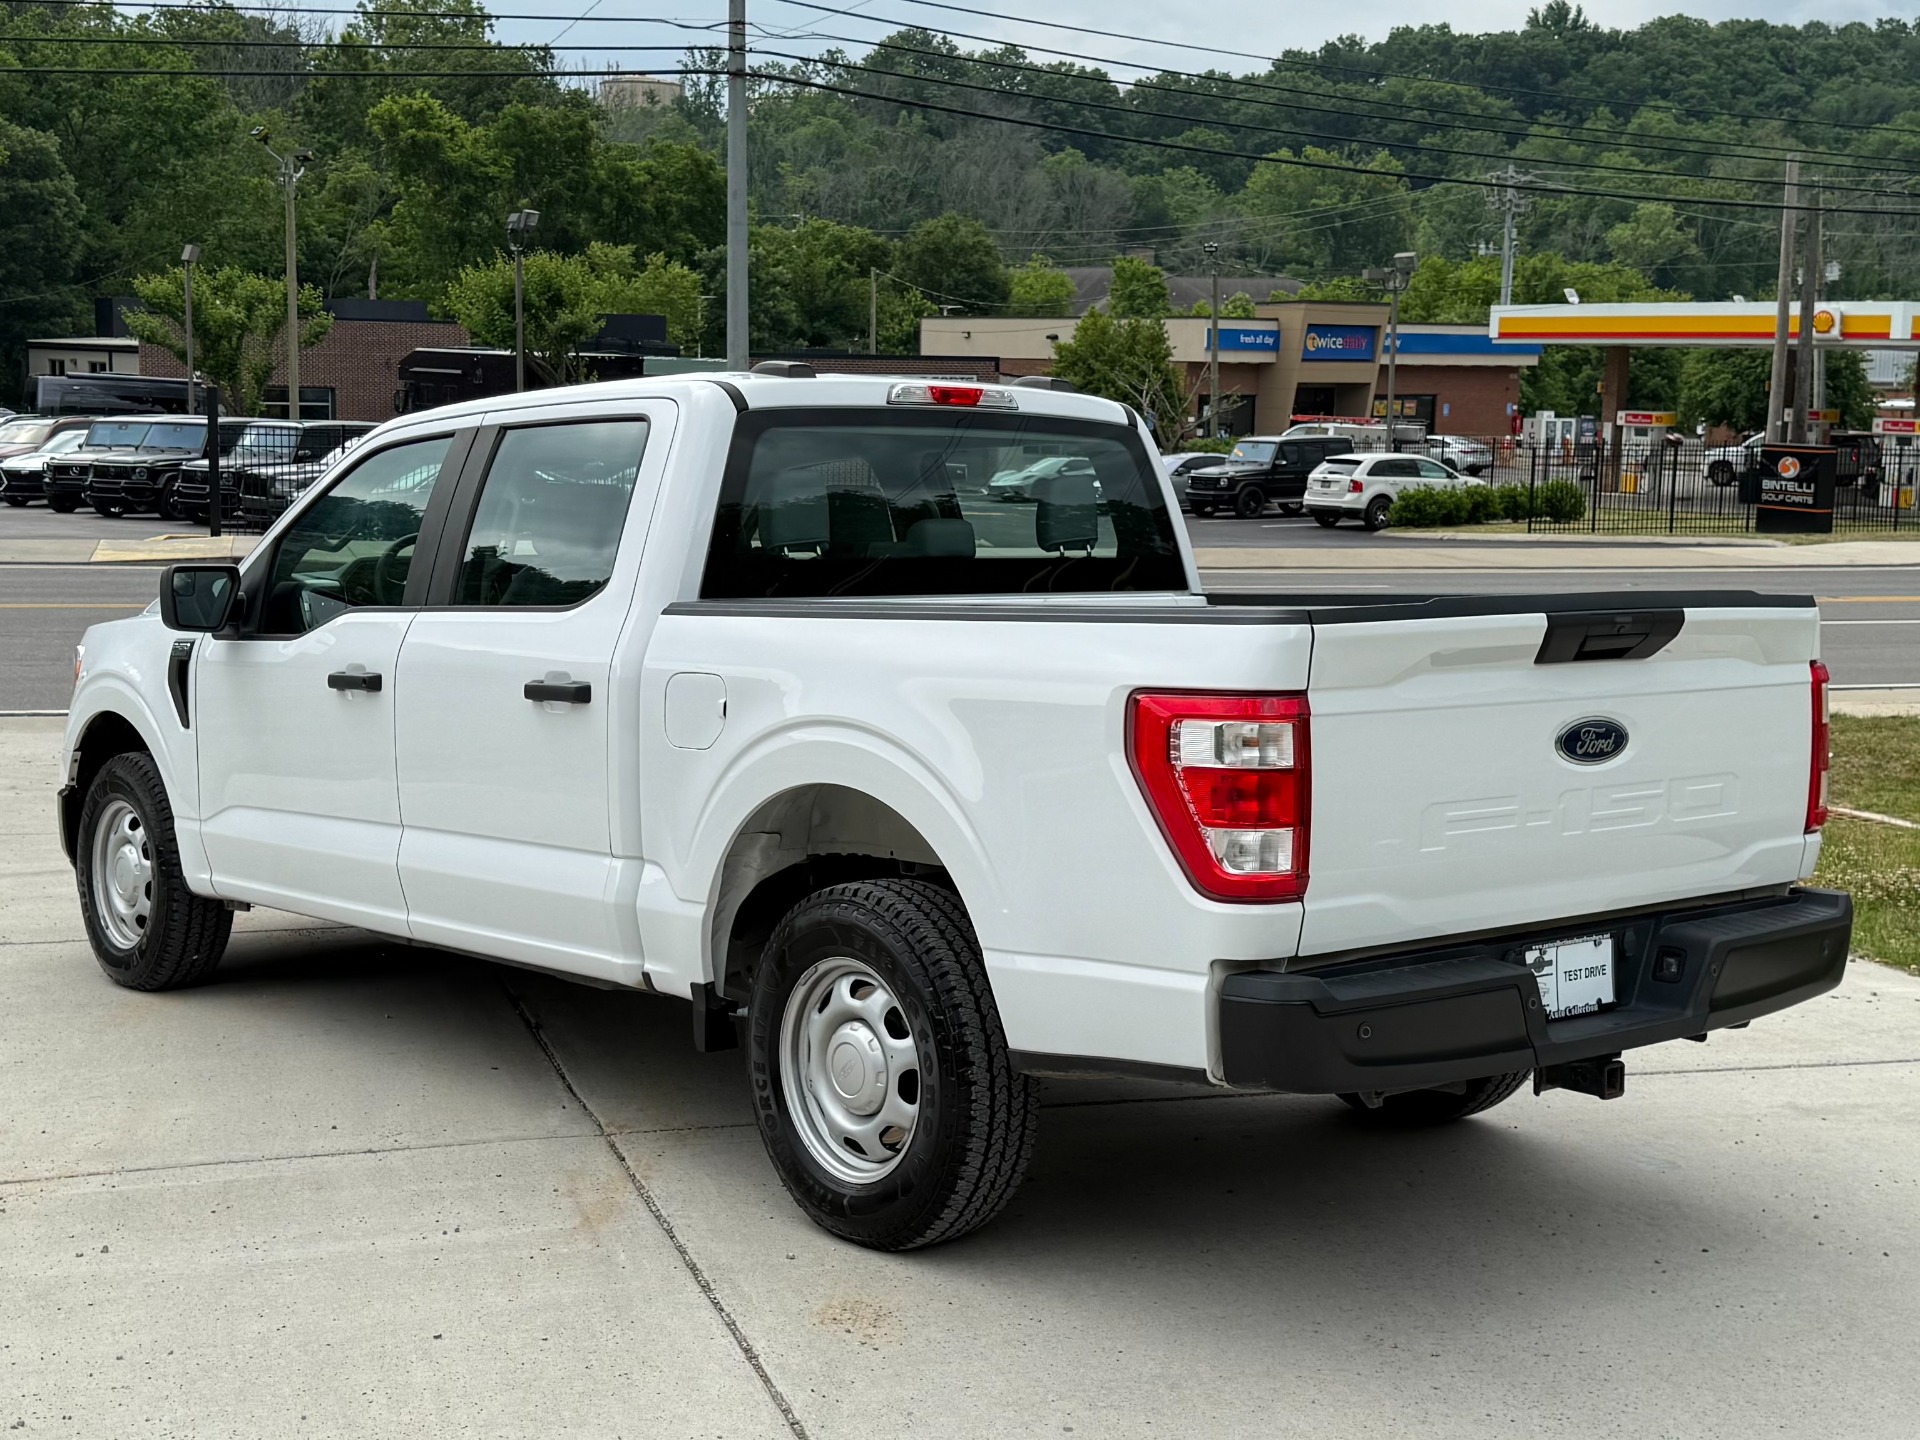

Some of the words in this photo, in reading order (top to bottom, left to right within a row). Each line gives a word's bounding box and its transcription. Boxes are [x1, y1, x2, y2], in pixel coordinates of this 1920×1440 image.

[1240, 334, 1255, 343] fresh
[1263, 335, 1275, 346] day
[1762, 480, 1815, 493] BINTELLI
[1761, 493, 1784, 502] GOLF
[1785, 494, 1814, 504] CARTS
[1576, 727, 1616, 755] Ford
[1419, 771, 1740, 852] F-150
[1563, 968, 1583, 982] TEST
[1584, 964, 1607, 979] DRIVE
[1565, 1003, 1599, 1016] Collection
